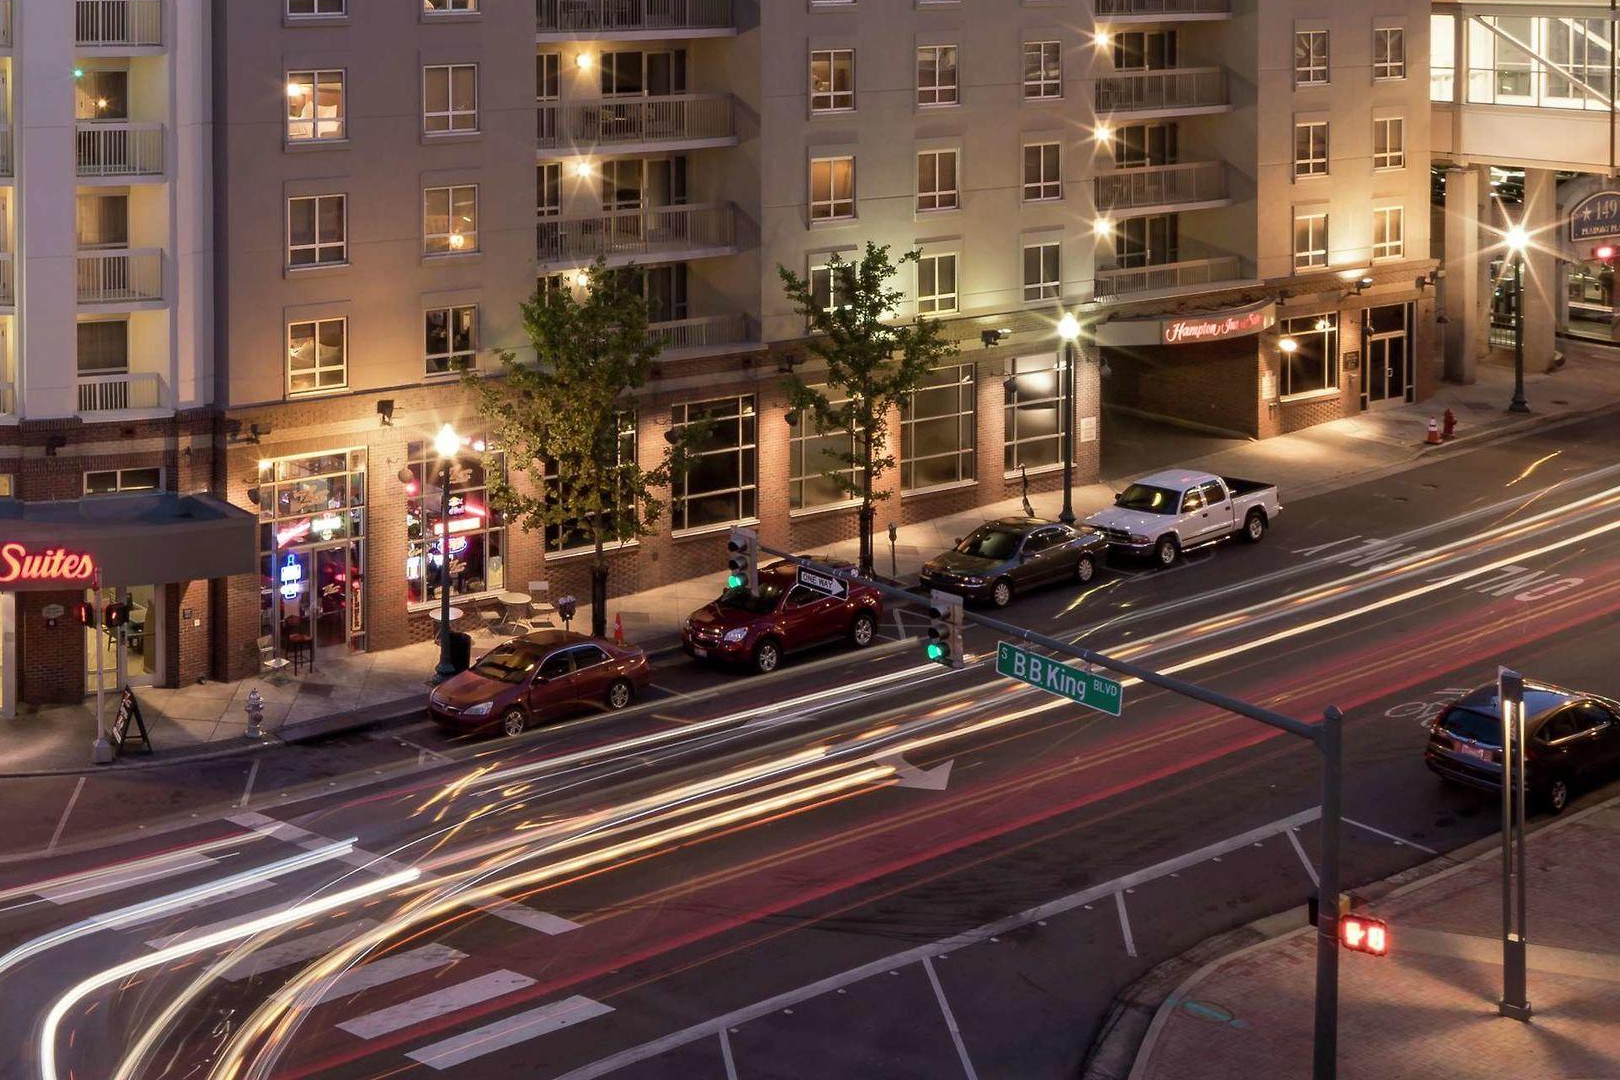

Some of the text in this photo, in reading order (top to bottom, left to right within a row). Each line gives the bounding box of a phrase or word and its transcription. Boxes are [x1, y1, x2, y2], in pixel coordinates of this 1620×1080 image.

[1596, 199, 1618, 221] 149
[1166, 322, 1220, 341] Hampton
[801, 571, 833, 589] ONE WAY
[1001, 646, 1009, 660] S
[1093, 680, 1118, 696] BLVD
